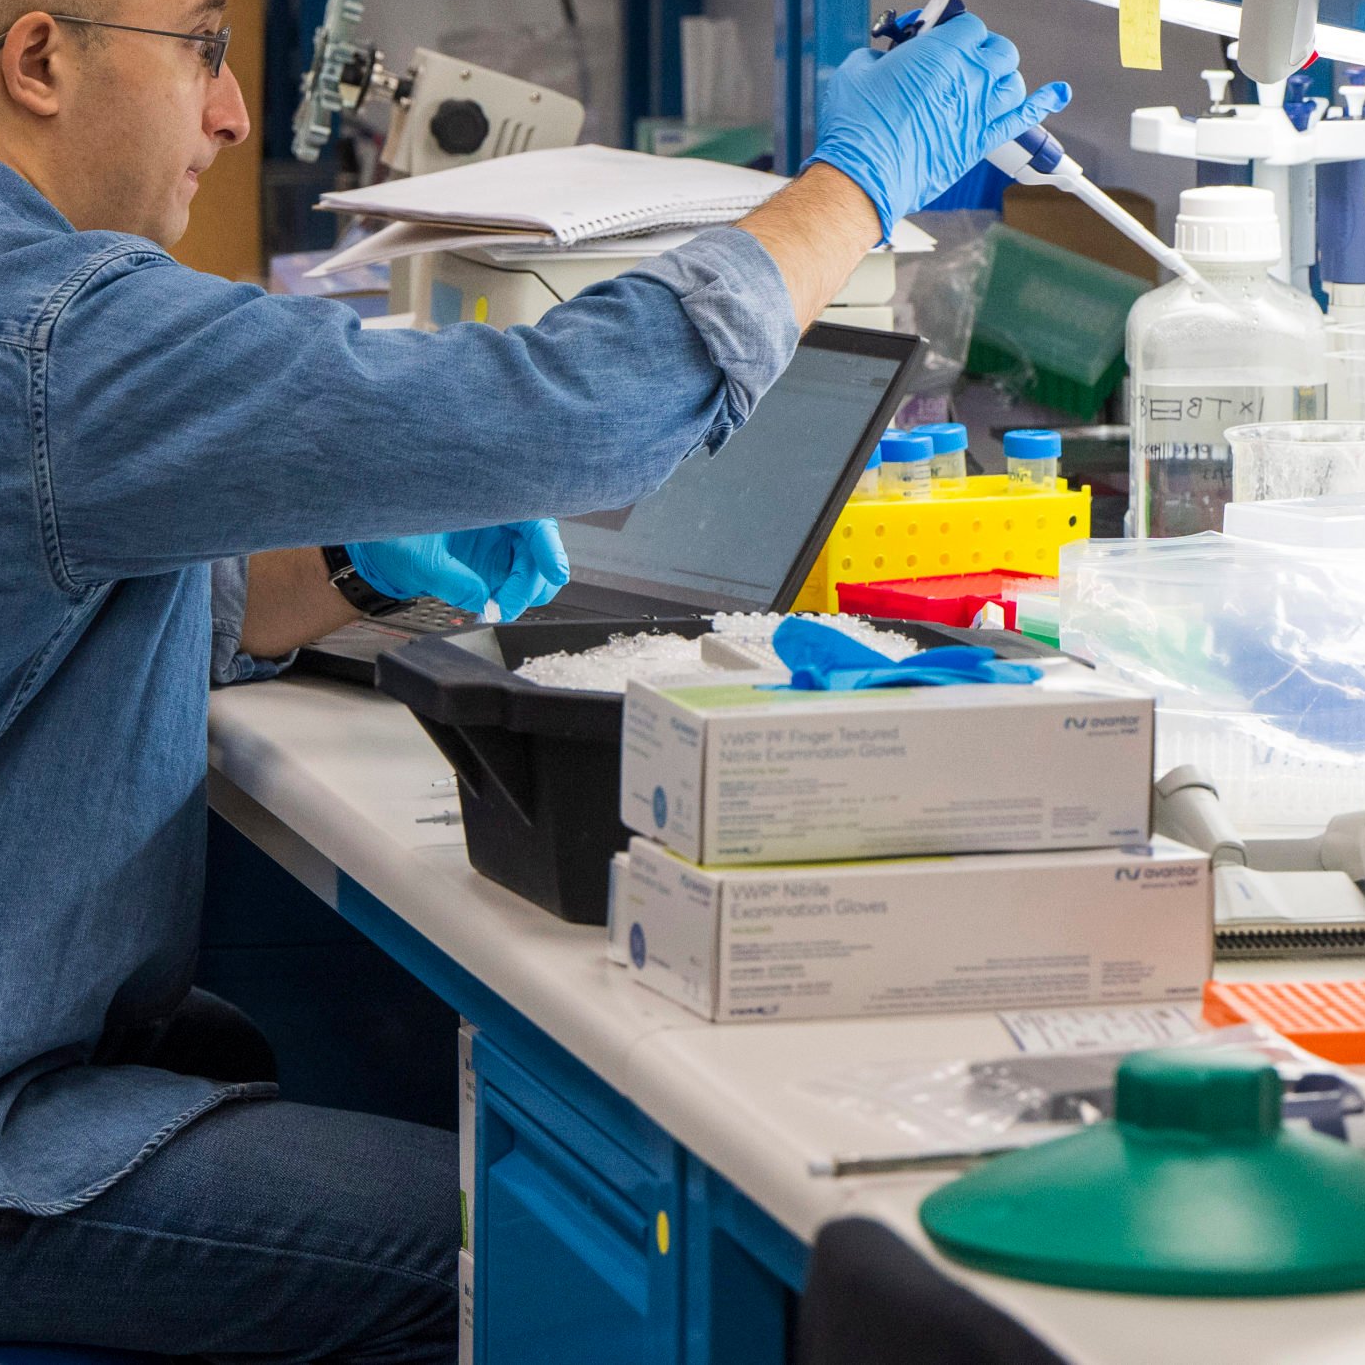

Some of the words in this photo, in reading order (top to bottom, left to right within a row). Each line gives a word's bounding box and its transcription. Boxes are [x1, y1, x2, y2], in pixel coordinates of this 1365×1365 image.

[1090, 715, 1139, 727] avantor
[1144, 866, 1198, 879] avantor
[835, 897, 888, 915] Gloves
